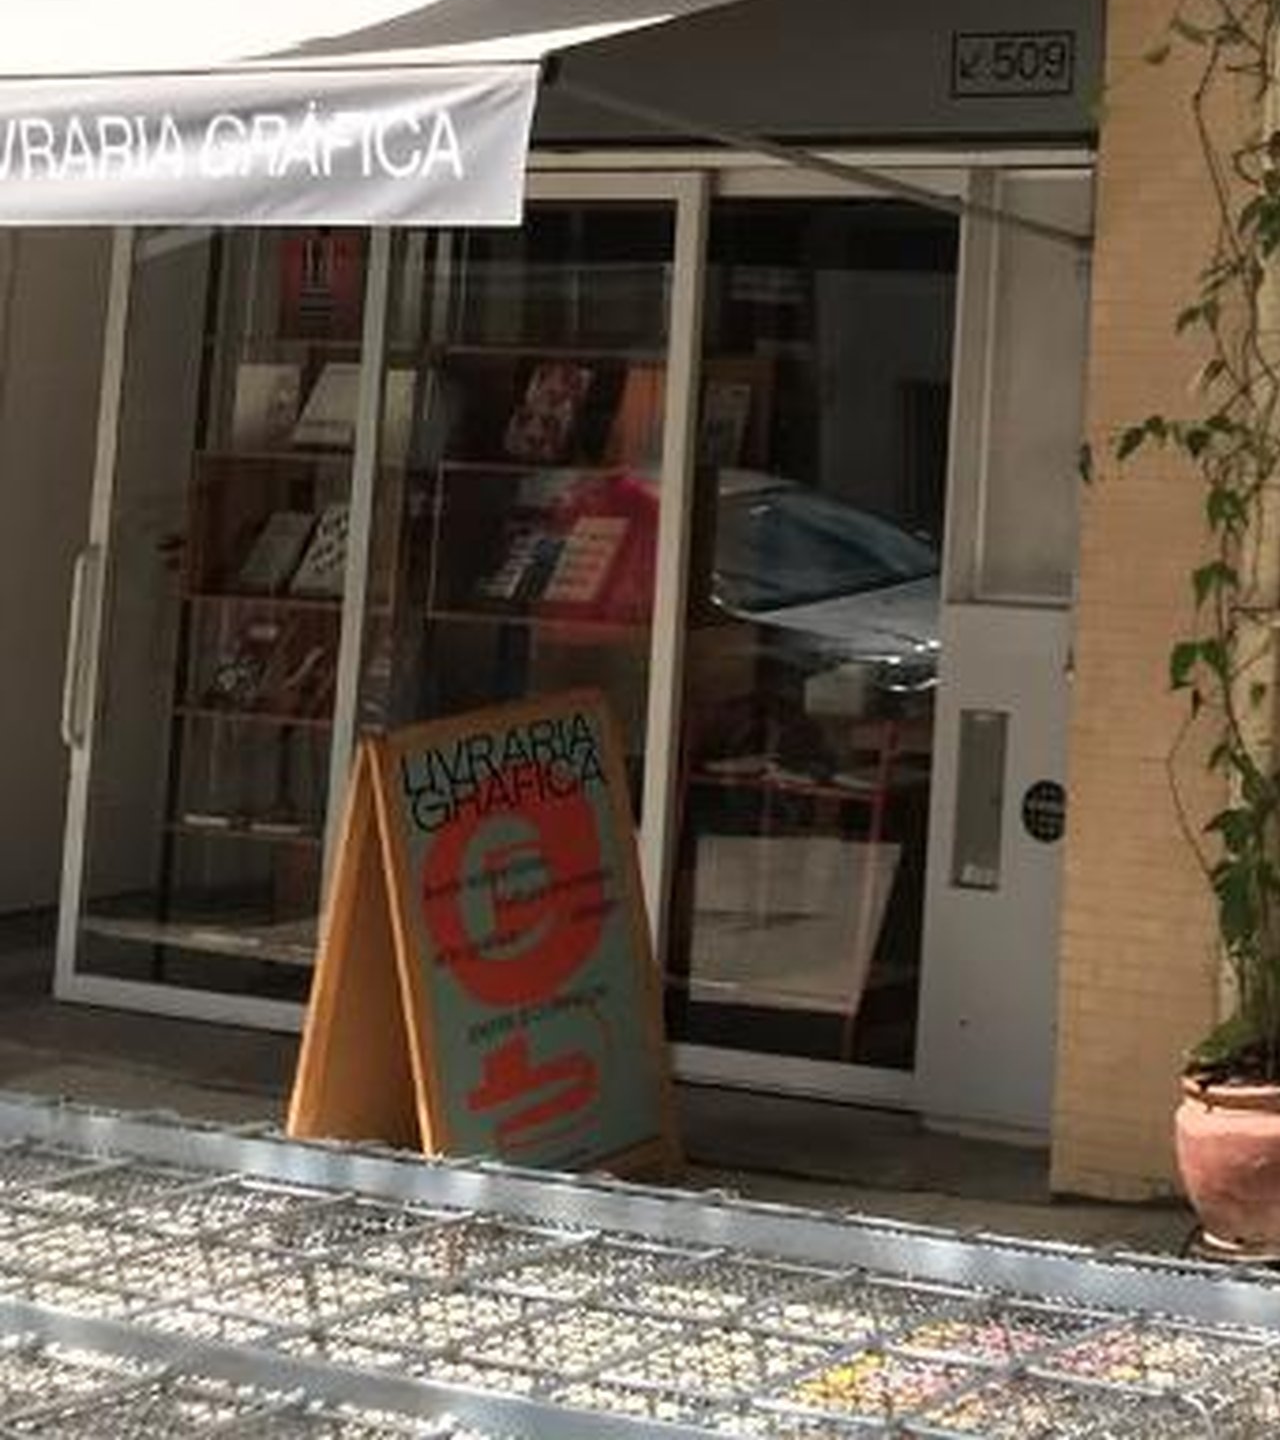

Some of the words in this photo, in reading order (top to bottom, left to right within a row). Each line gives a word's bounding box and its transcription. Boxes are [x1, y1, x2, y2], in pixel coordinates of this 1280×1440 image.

[994, 40, 1066, 80] 509
[205, 100, 464, 179] GRÁFICA
[401, 714, 597, 797] LIVRARIA
